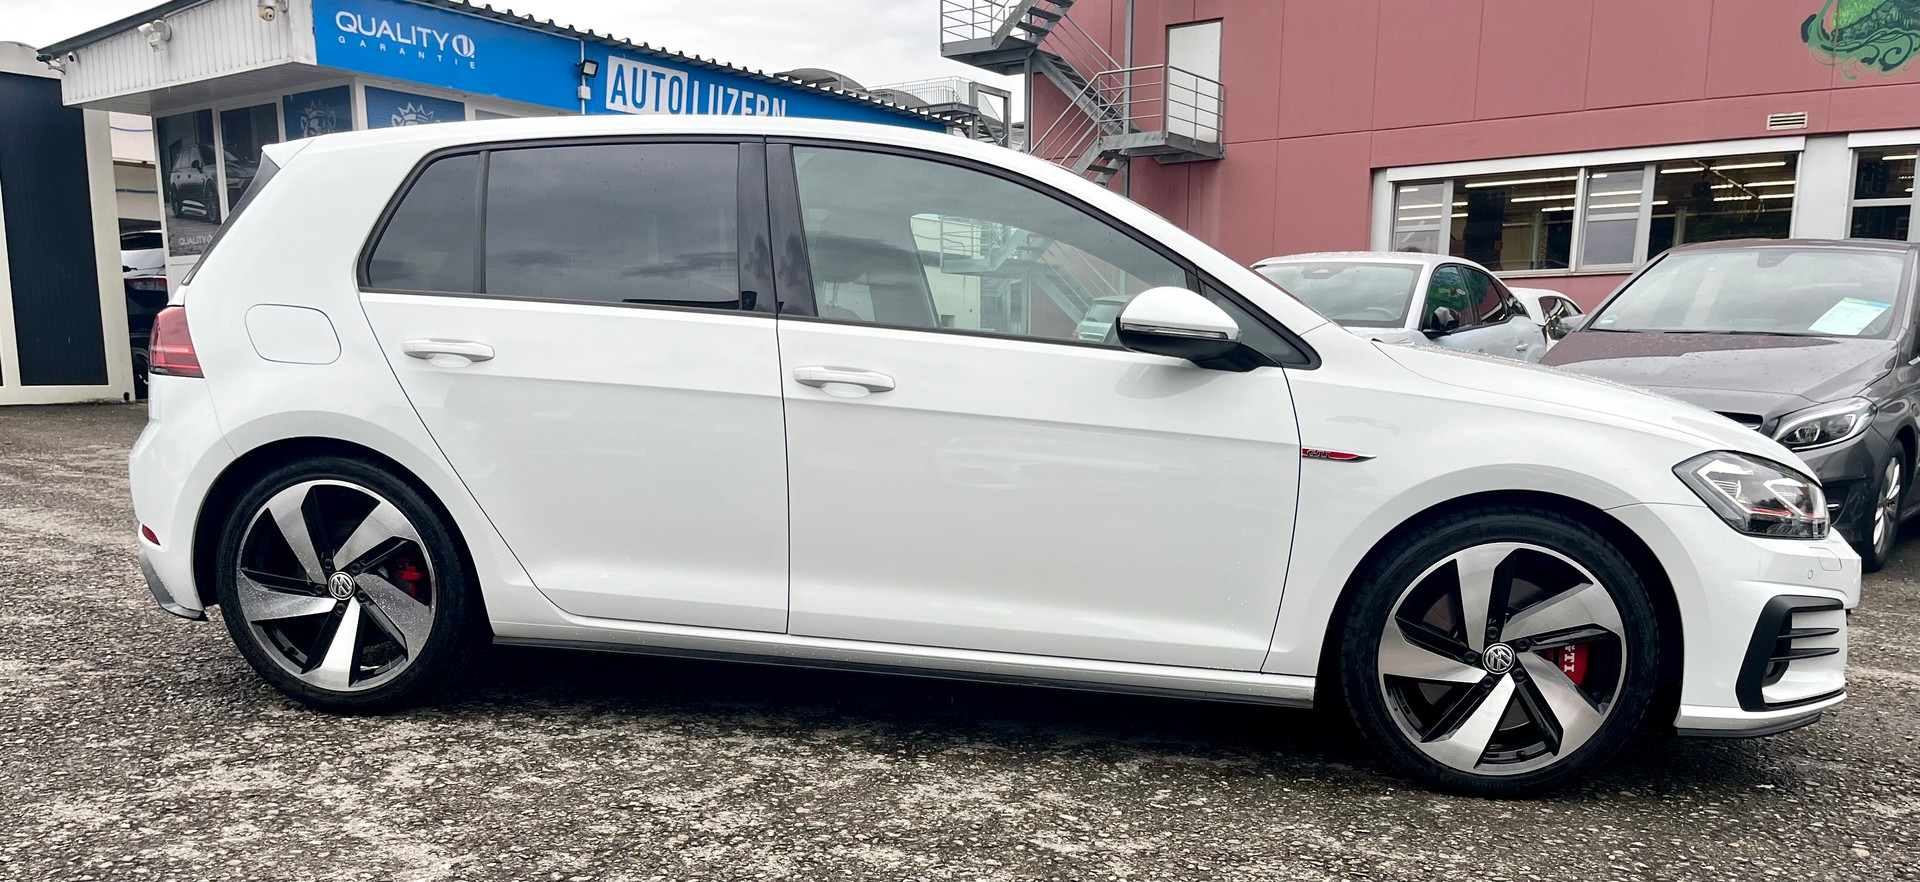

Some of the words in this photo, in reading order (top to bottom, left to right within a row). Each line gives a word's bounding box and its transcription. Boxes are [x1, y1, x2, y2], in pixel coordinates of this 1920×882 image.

[335, 11, 449, 51] QUALITY
[338, 35, 476, 69] GARANTIE
[610, 63, 684, 115] AUTO
